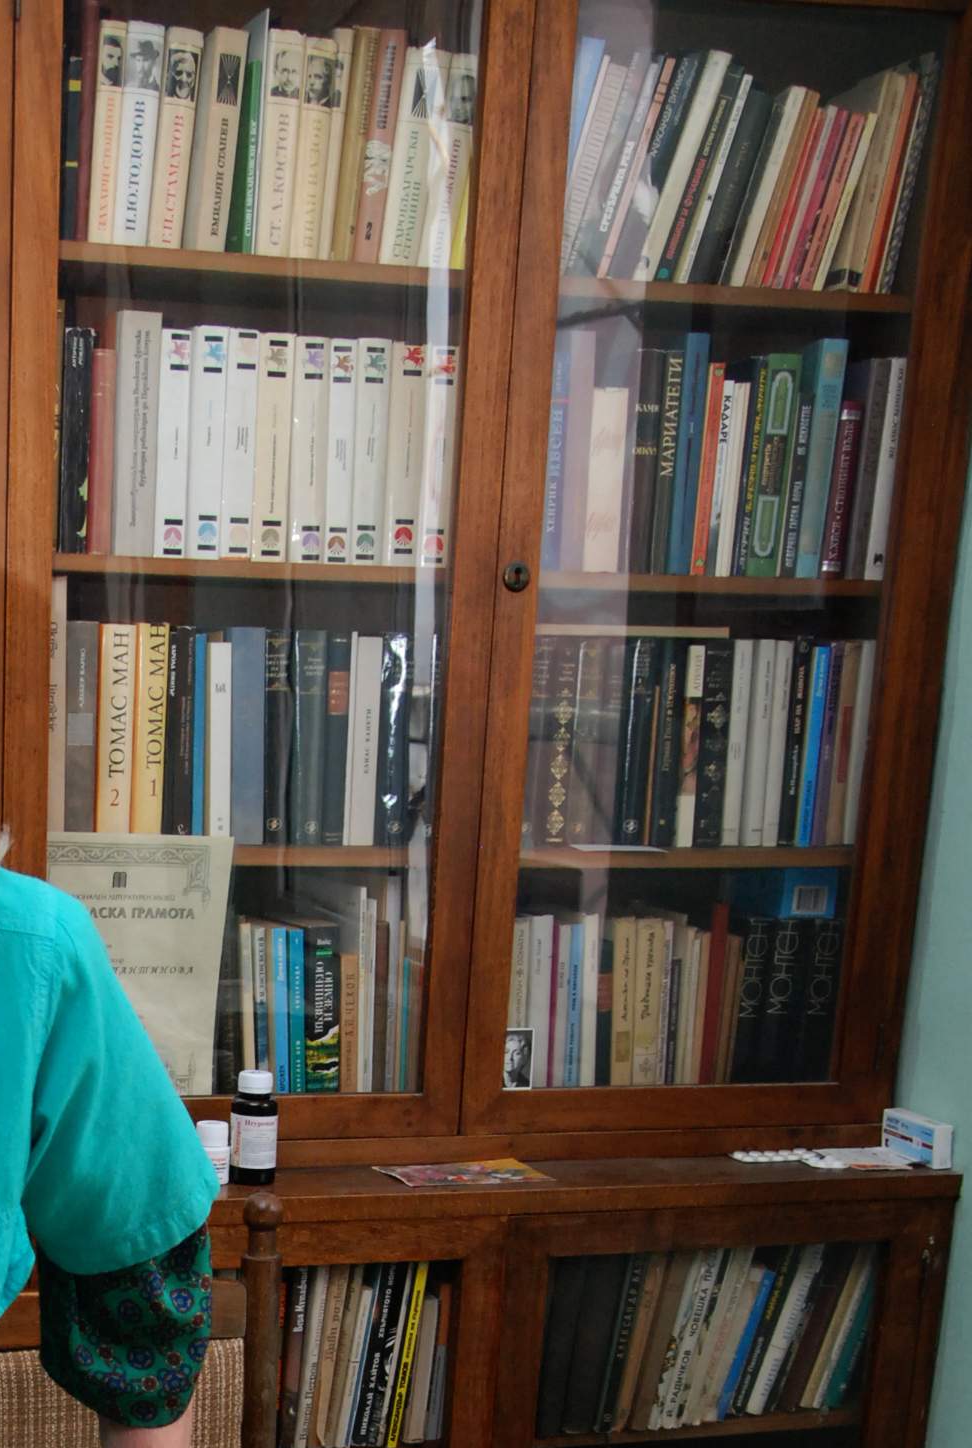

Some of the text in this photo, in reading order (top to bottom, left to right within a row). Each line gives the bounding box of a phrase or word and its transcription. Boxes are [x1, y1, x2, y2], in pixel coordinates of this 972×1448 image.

[547, 408, 564, 477] ИБСЕН
[659, 356, 684, 478] МАРИАТЕГИ
[718, 394, 733, 445] КАДАРЕ
[108, 631, 130, 778] ТОМАС МАН
[146, 623, 166, 770] ТОМАС МАН
[109, 788, 120, 807] 2
[150, 778, 157, 797] 1
[130, 906, 195, 920] ГРАМОТА
[315, 961, 325, 1033] ВЪЗВИШЕНО
[324, 971, 333, 1010] ЗЕМНО
[616, 1288, 640, 1360] АЛЕКСАНДЪР
[670, 1349, 693, 1404] РАДИЧКОВ
[687, 1287, 710, 1338] ЧОВЕШКА
[304, 1361, 318, 1400] Петров
[360, 1392, 374, 1436] НИКОЛАЙ
[367, 1352, 381, 1389] ХАЙТОВ
[390, 1361, 409, 1442] АЛЕКСАНДЪР ТОМОВ
